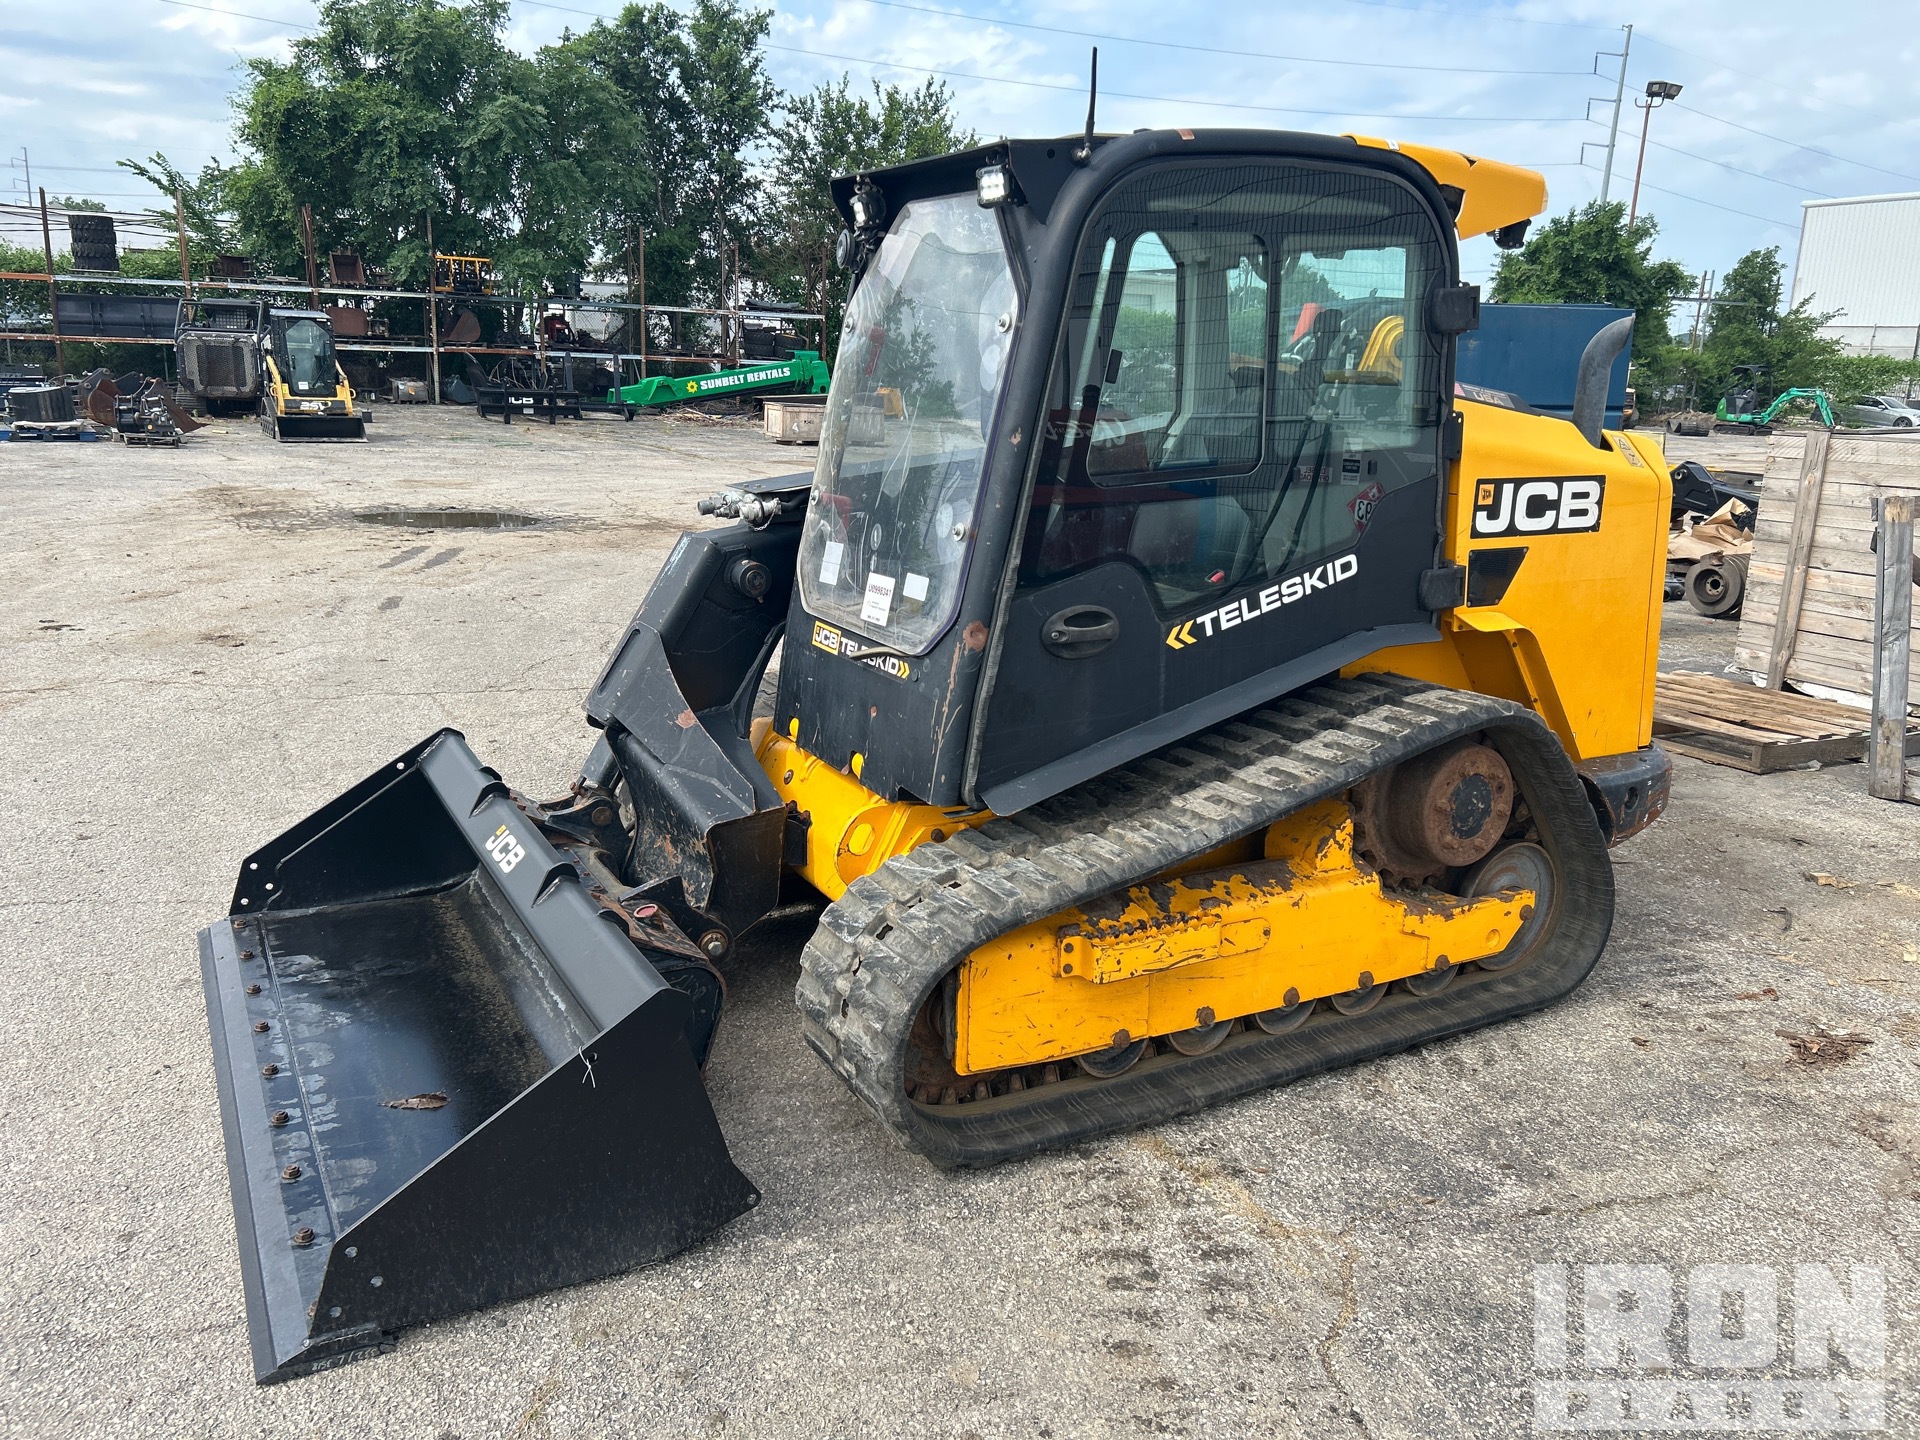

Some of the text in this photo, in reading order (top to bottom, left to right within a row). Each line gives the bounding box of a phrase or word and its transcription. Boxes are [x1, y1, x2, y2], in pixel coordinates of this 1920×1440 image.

[700, 366, 791, 390] SUNBELT RENTALS
[1473, 391, 1505, 406] USA
[1475, 480, 1600, 534] JCB
[1196, 553, 1359, 637] TELESKID
[815, 627, 838, 650] JCB
[484, 829, 526, 874] JCB
